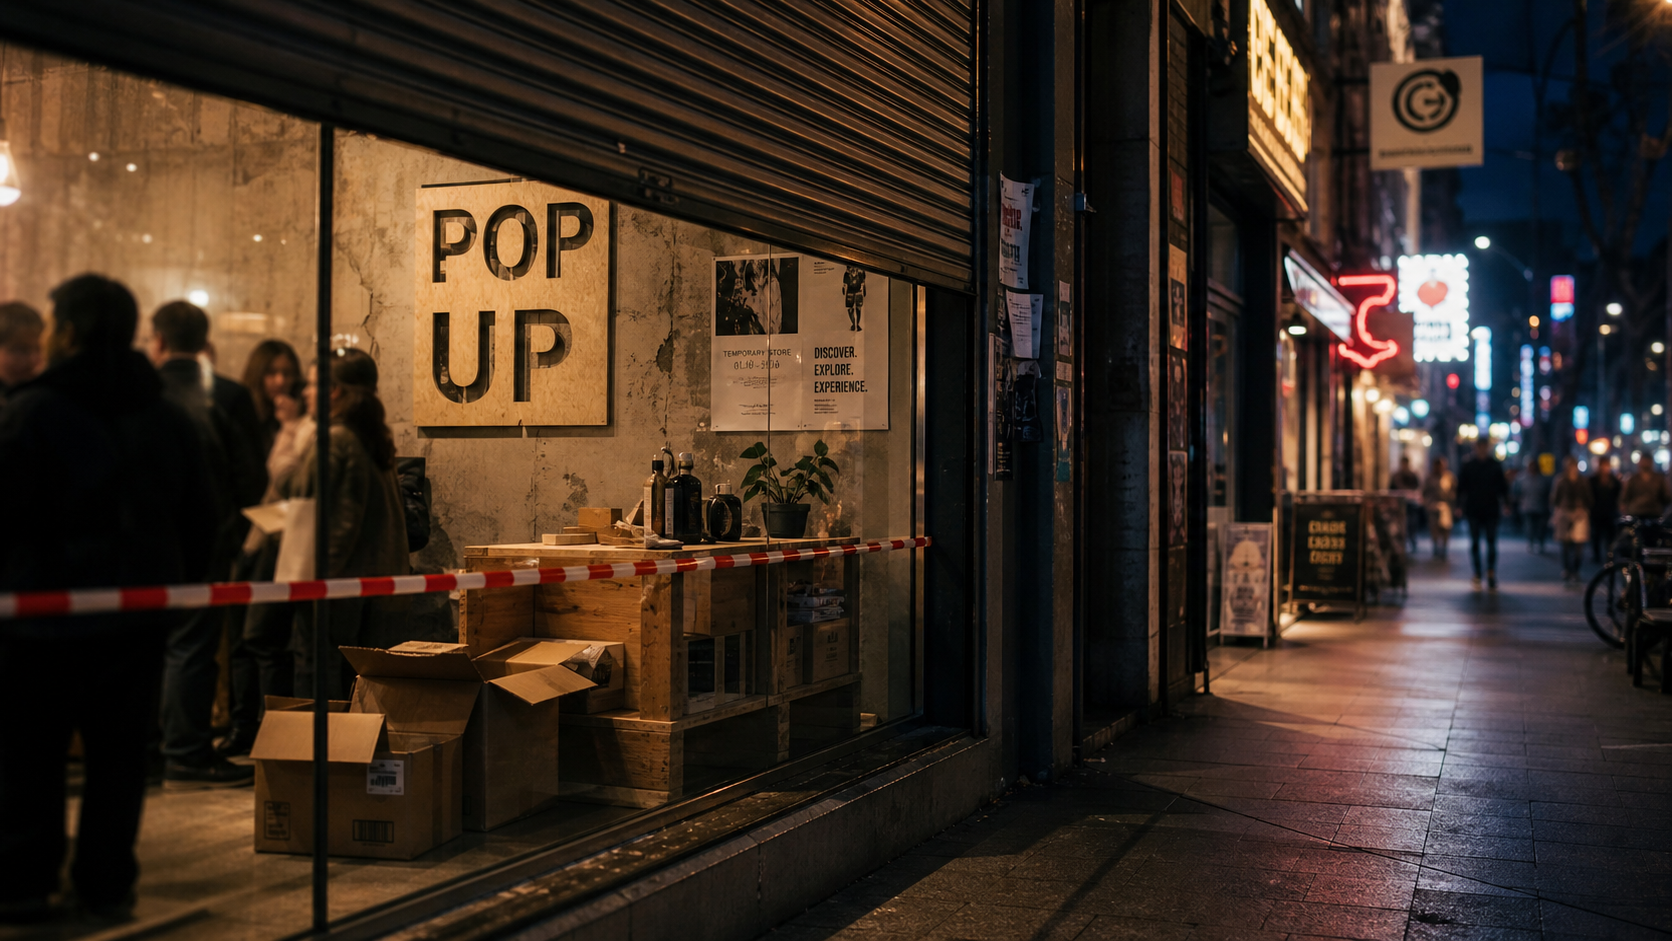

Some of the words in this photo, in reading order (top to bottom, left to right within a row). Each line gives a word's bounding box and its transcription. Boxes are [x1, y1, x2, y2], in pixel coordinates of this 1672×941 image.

[432, 202, 594, 283] POP
[432, 308, 573, 404] UP
[723, 349, 765, 357] TEMPORARY
[768, 348, 792, 356] STORE
[814, 346, 857, 359] DISCOVER.
[814, 363, 854, 376] EXPLORE.
[814, 380, 868, 394] EXPERIENCE.
